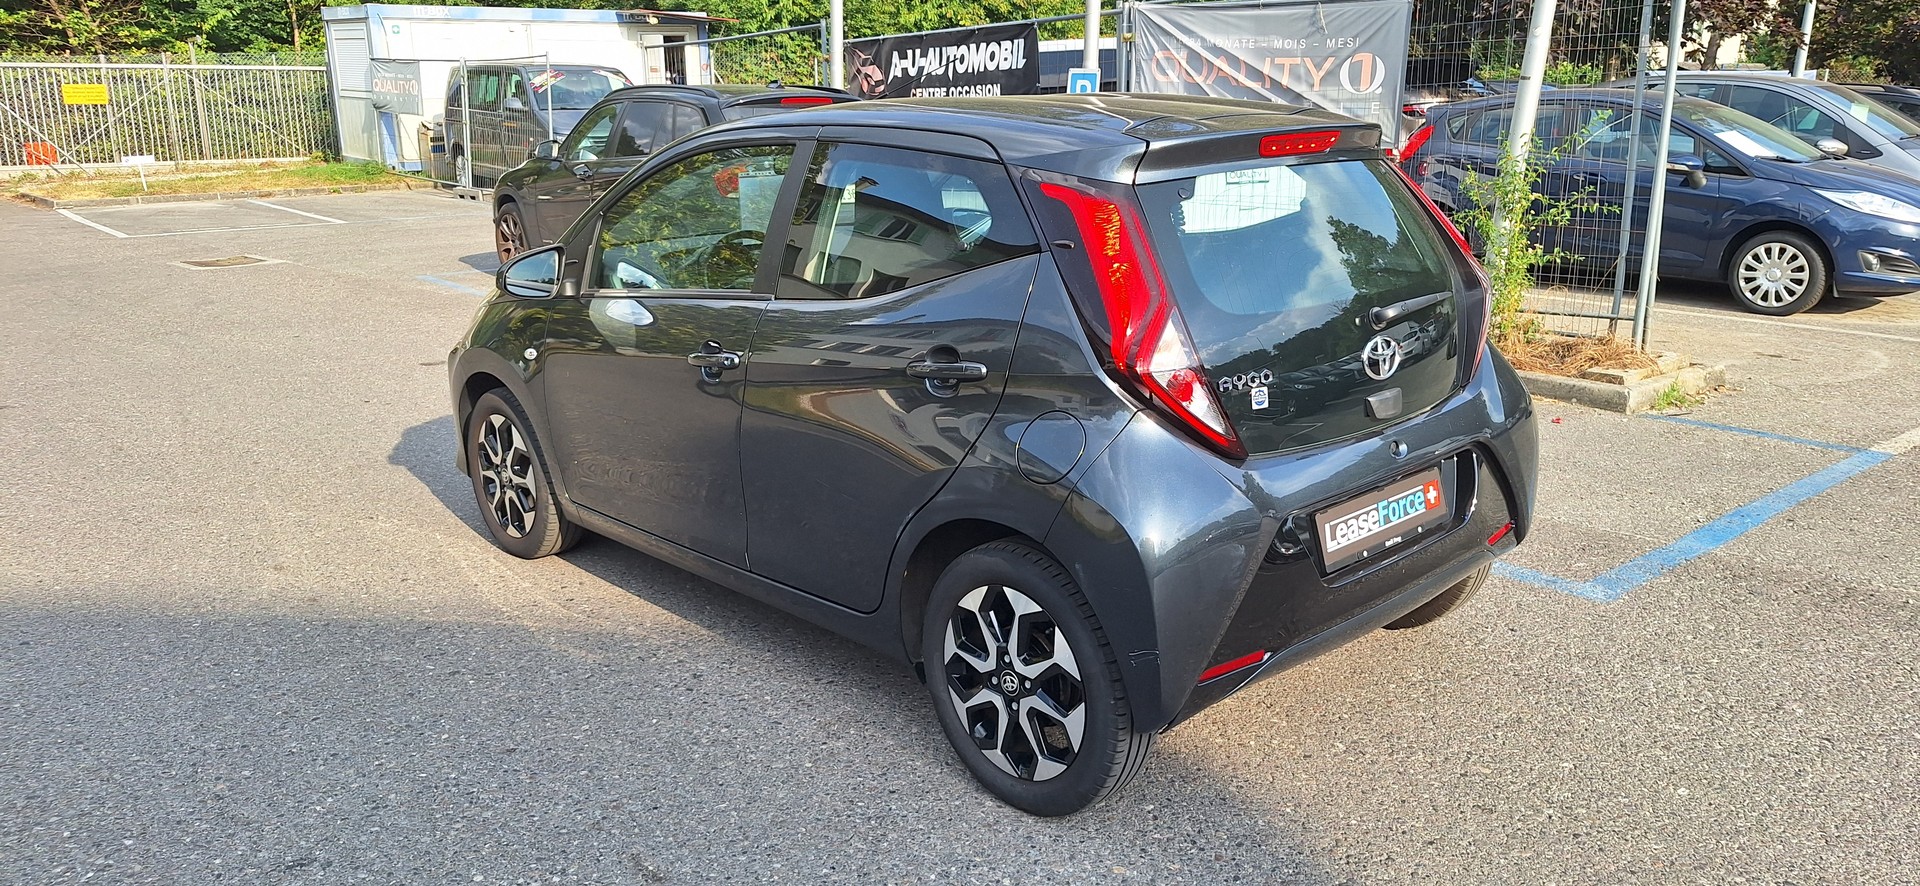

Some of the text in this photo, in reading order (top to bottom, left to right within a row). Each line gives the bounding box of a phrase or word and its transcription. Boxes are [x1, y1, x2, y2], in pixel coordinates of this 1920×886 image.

[1273, 38, 1307, 49] MOIS
[1326, 37, 1360, 48] MESI
[1151, 50, 1336, 92] QUALITY
[373, 79, 410, 94] QUALITY
[910, 83, 1001, 98] CENTRE OCCASION
[1218, 368, 1274, 392] AYGO
[1324, 490, 1426, 549] LeaseForce
